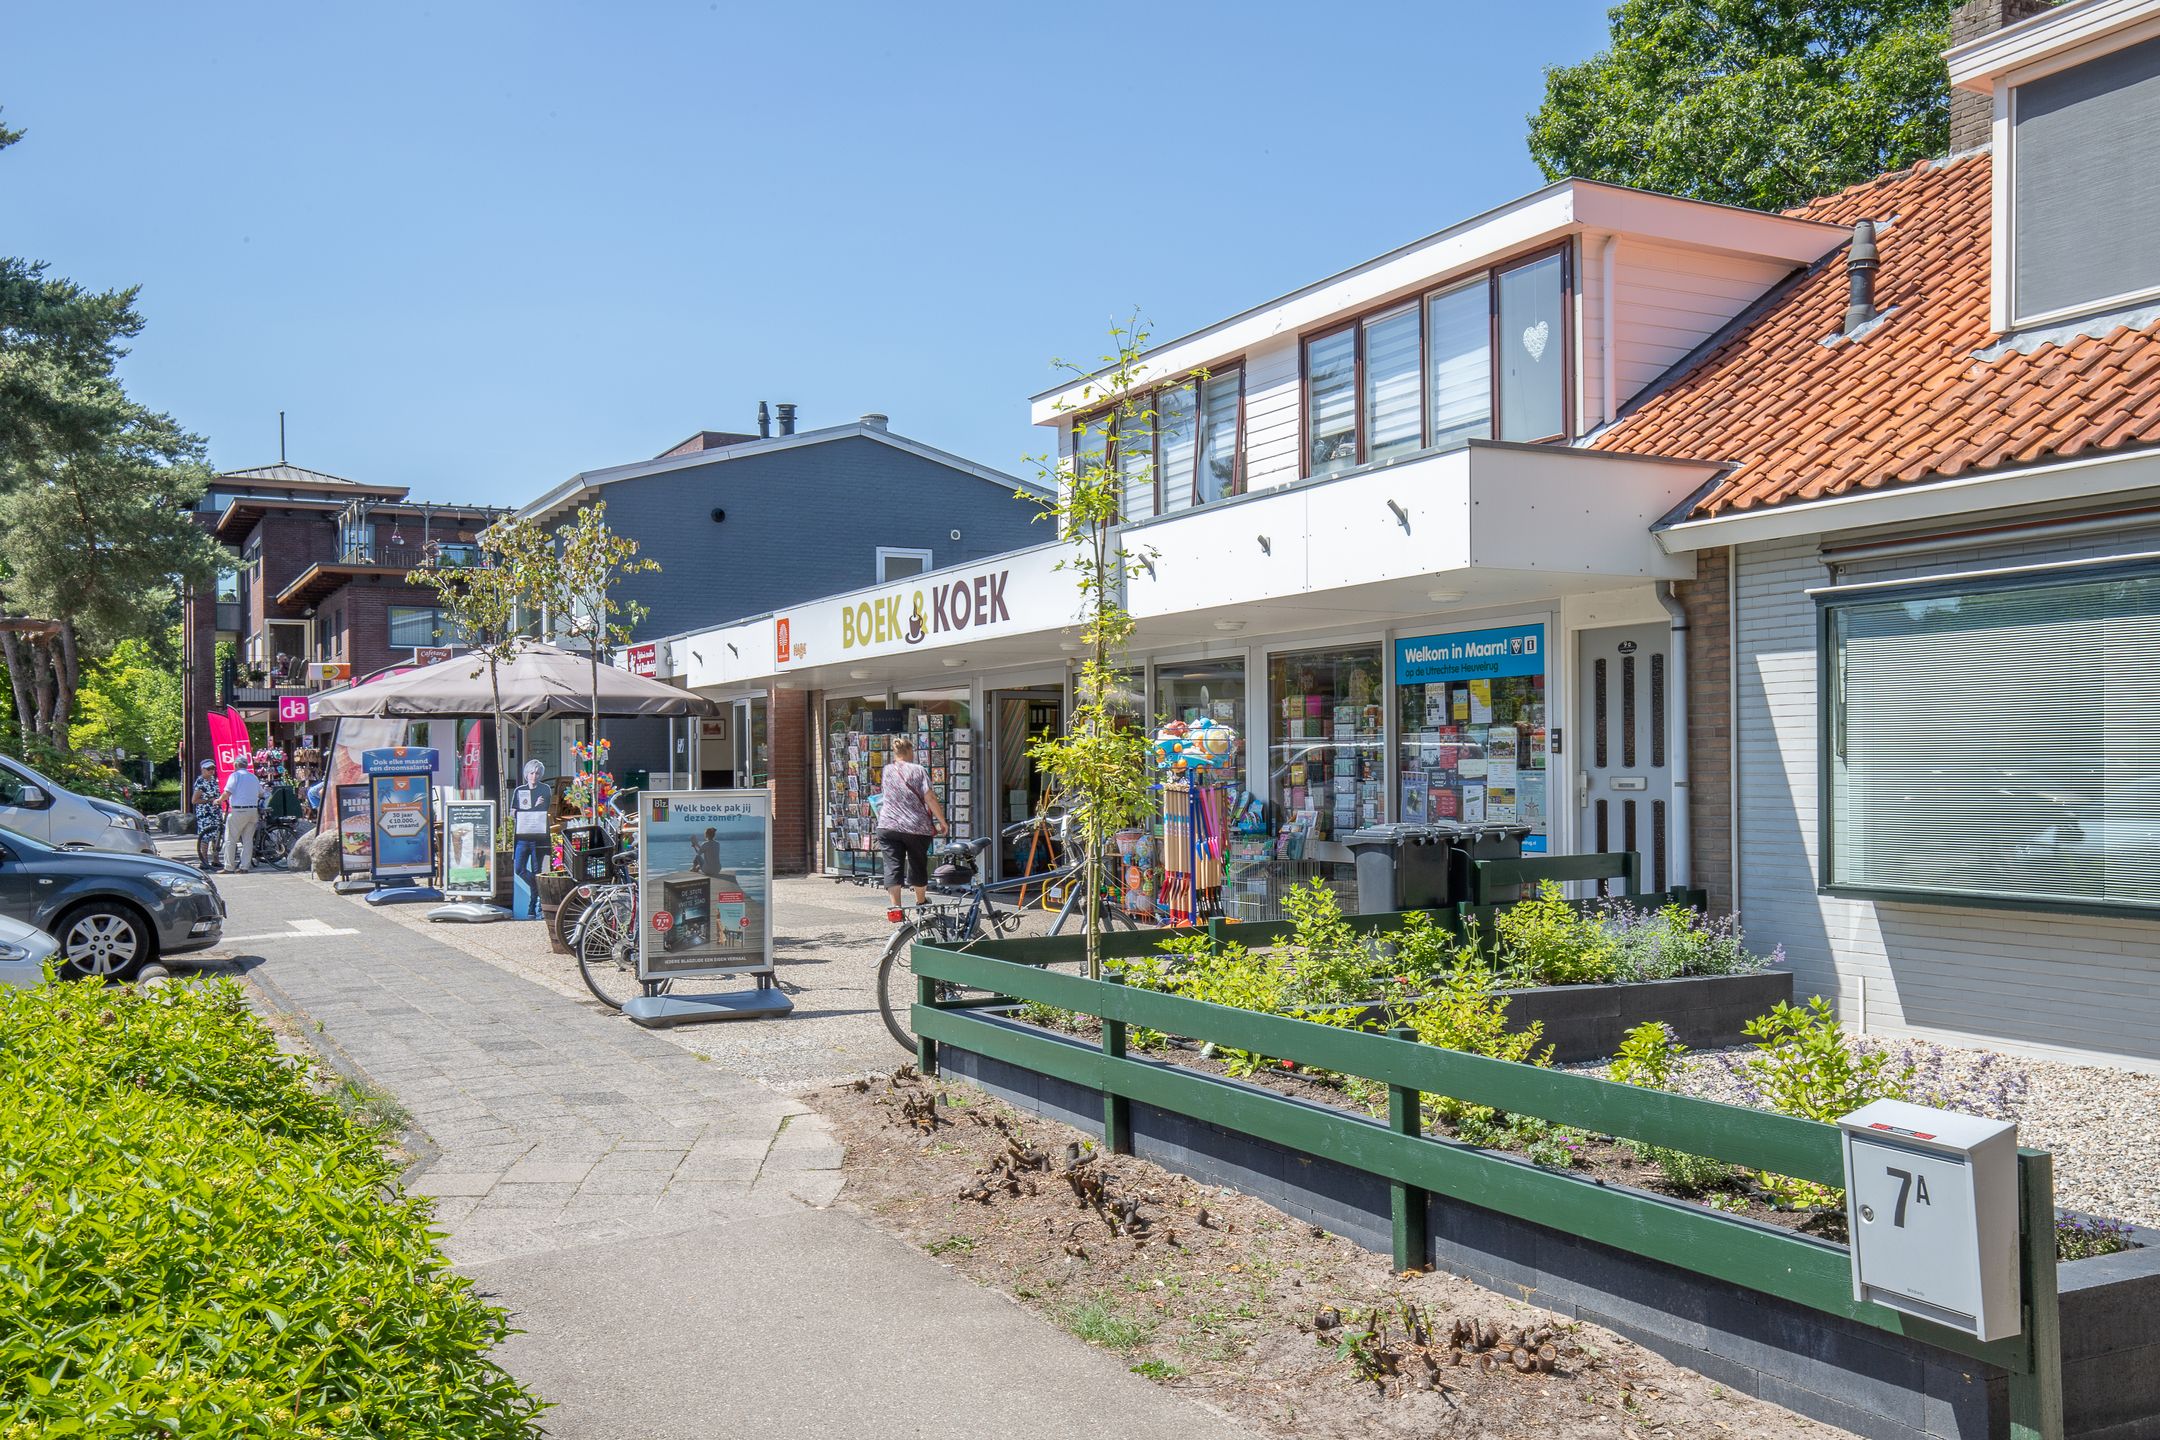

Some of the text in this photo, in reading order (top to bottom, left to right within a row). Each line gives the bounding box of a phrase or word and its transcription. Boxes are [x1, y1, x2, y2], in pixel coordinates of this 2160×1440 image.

[842, 594, 902, 649] BOEK
[932, 570, 1010, 633] KOEK
[1405, 646, 1449, 663] Welkom
[1451, 643, 1462, 659] in
[1465, 639, 1507, 658] Maarn!
[1405, 662, 1499, 678] op de Utrechtse Heuvelrug
[282, 700, 306, 718] da
[674, 804, 751, 813] Welk boek pak jij
[684, 814, 742, 822] deze zomer?
[1886, 1166, 1931, 1229] 7A
